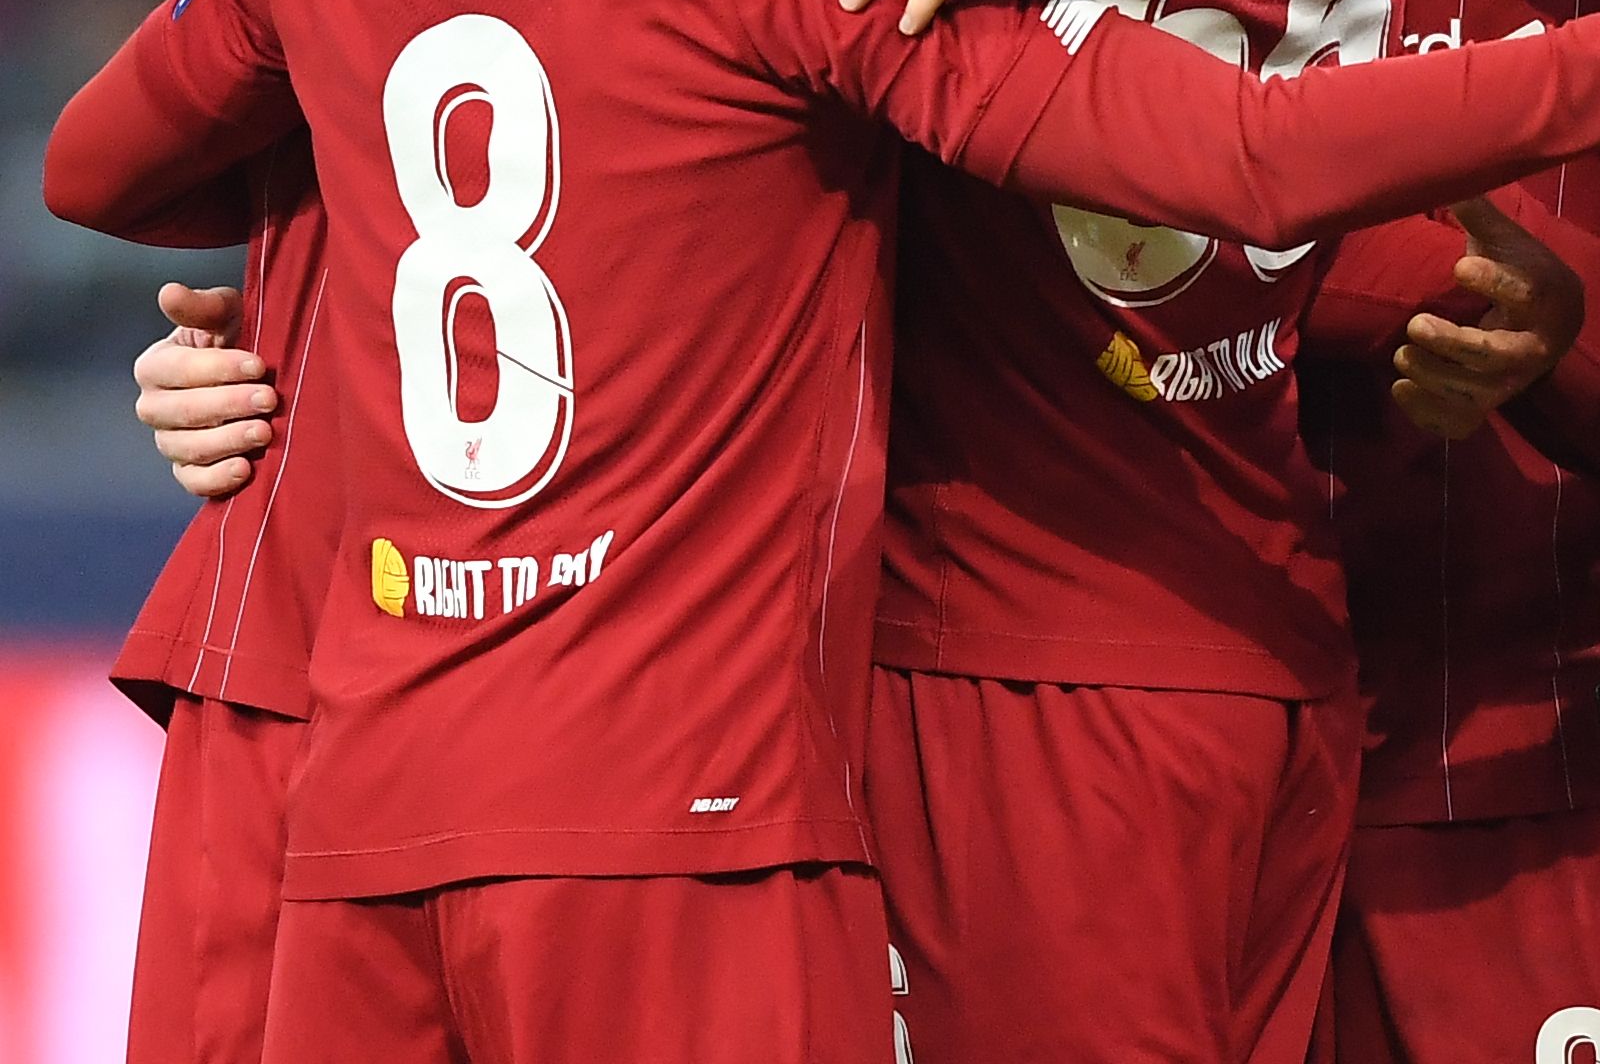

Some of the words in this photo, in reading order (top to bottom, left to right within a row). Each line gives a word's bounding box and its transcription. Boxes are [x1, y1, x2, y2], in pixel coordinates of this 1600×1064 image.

[383, 13, 574, 509] 8
[414, 556, 493, 620] RIGHT
[498, 556, 539, 614] TO
[710, 797, 740, 811] DRY
